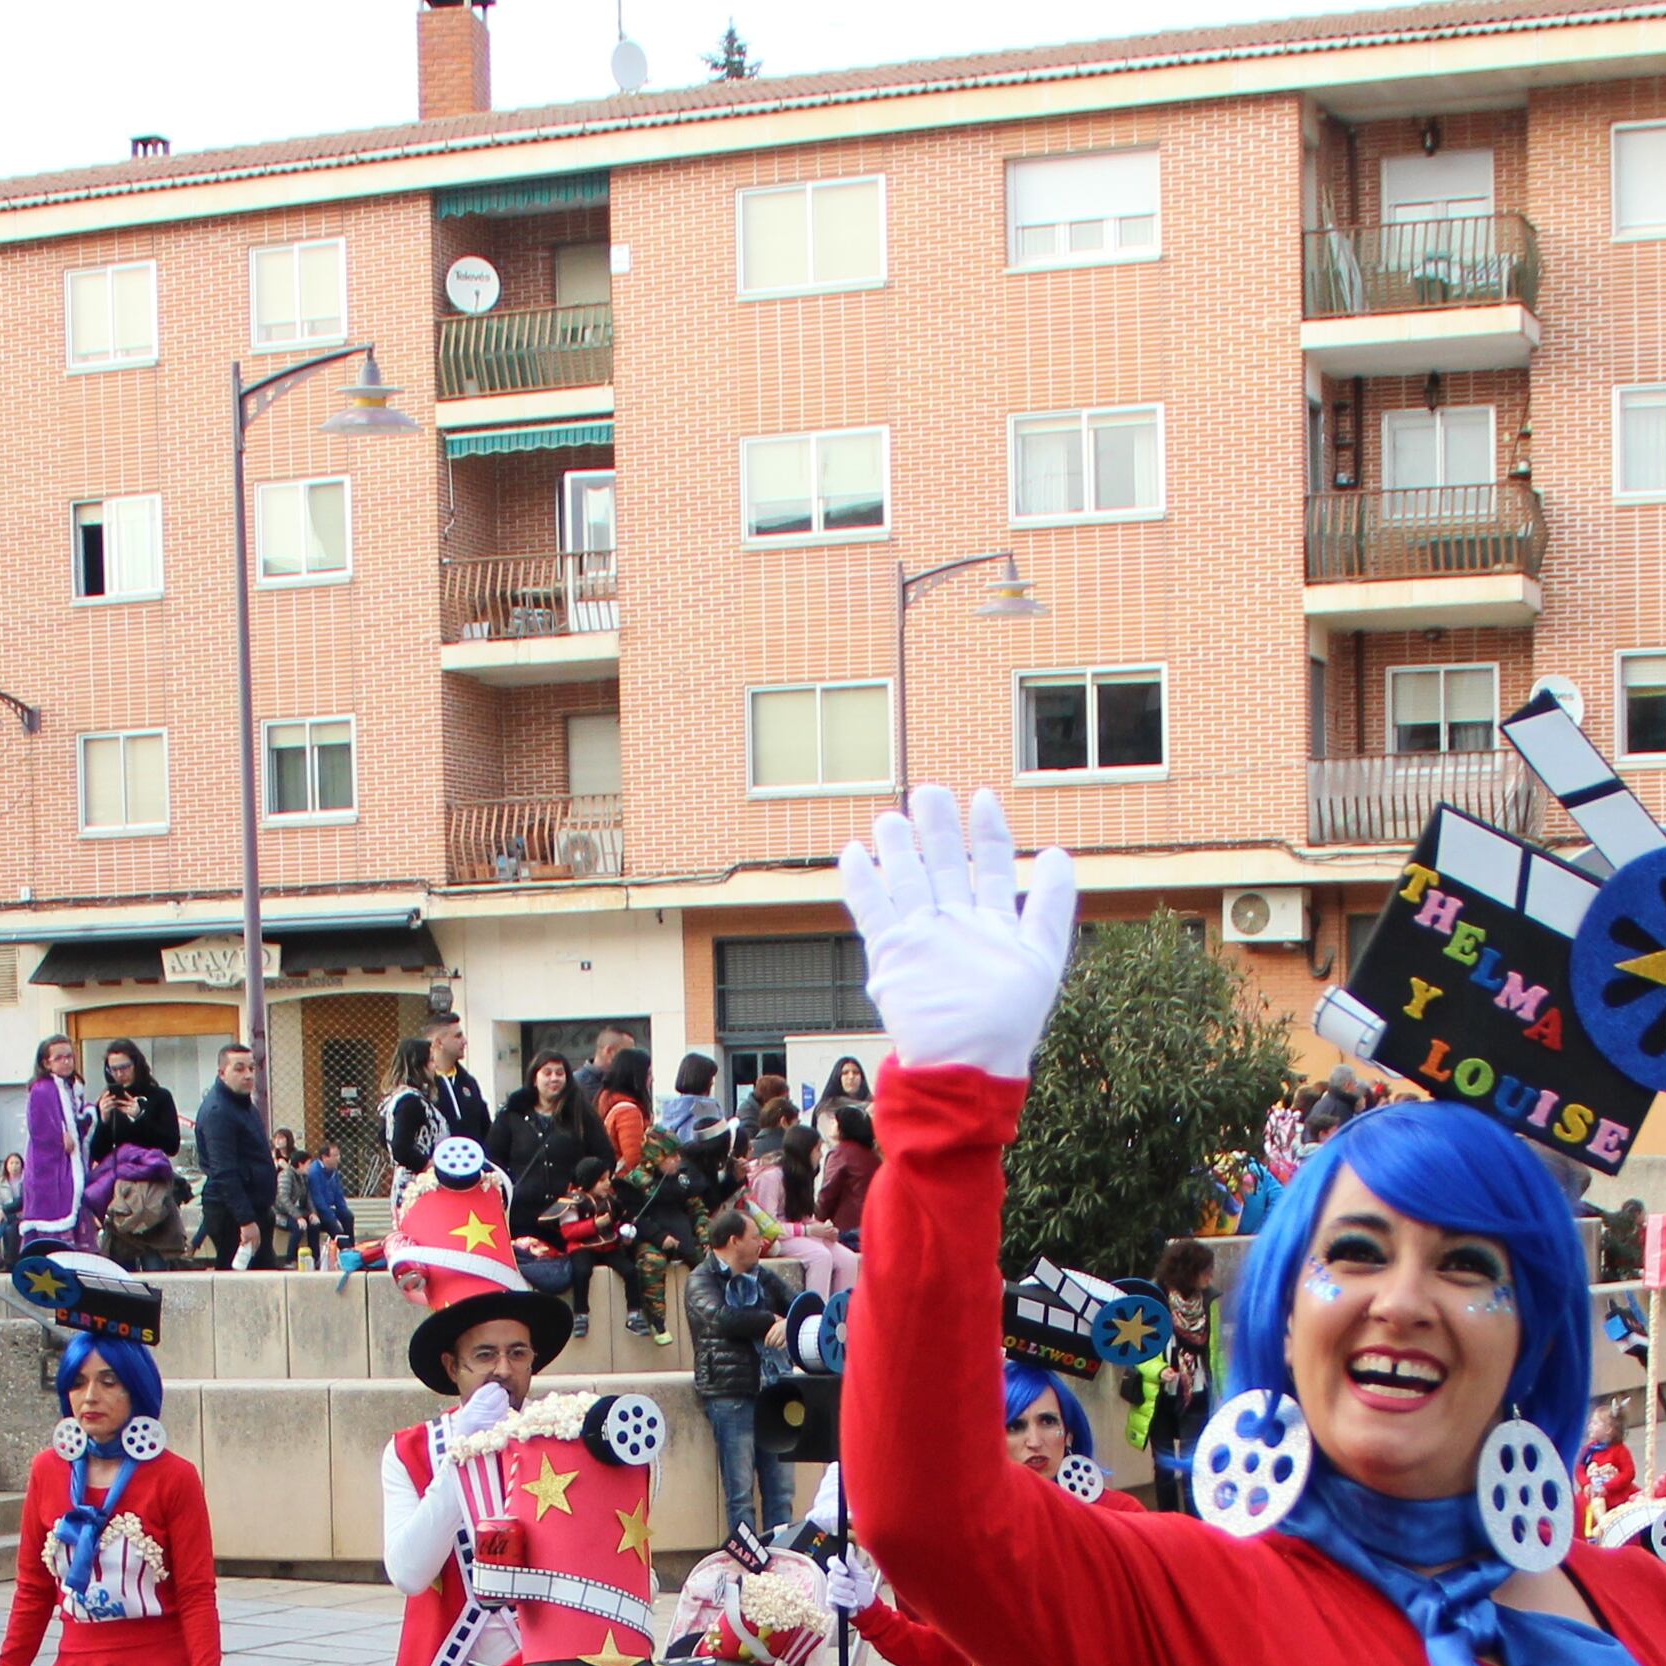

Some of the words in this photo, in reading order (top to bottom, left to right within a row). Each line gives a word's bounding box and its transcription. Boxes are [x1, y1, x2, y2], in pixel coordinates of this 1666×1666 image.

[1399, 863, 1564, 1050] THELMA
[1402, 976, 1444, 1020] Y
[1418, 1038, 1630, 1164] LOUISE
[56, 1307, 154, 1342] CARTOONS
